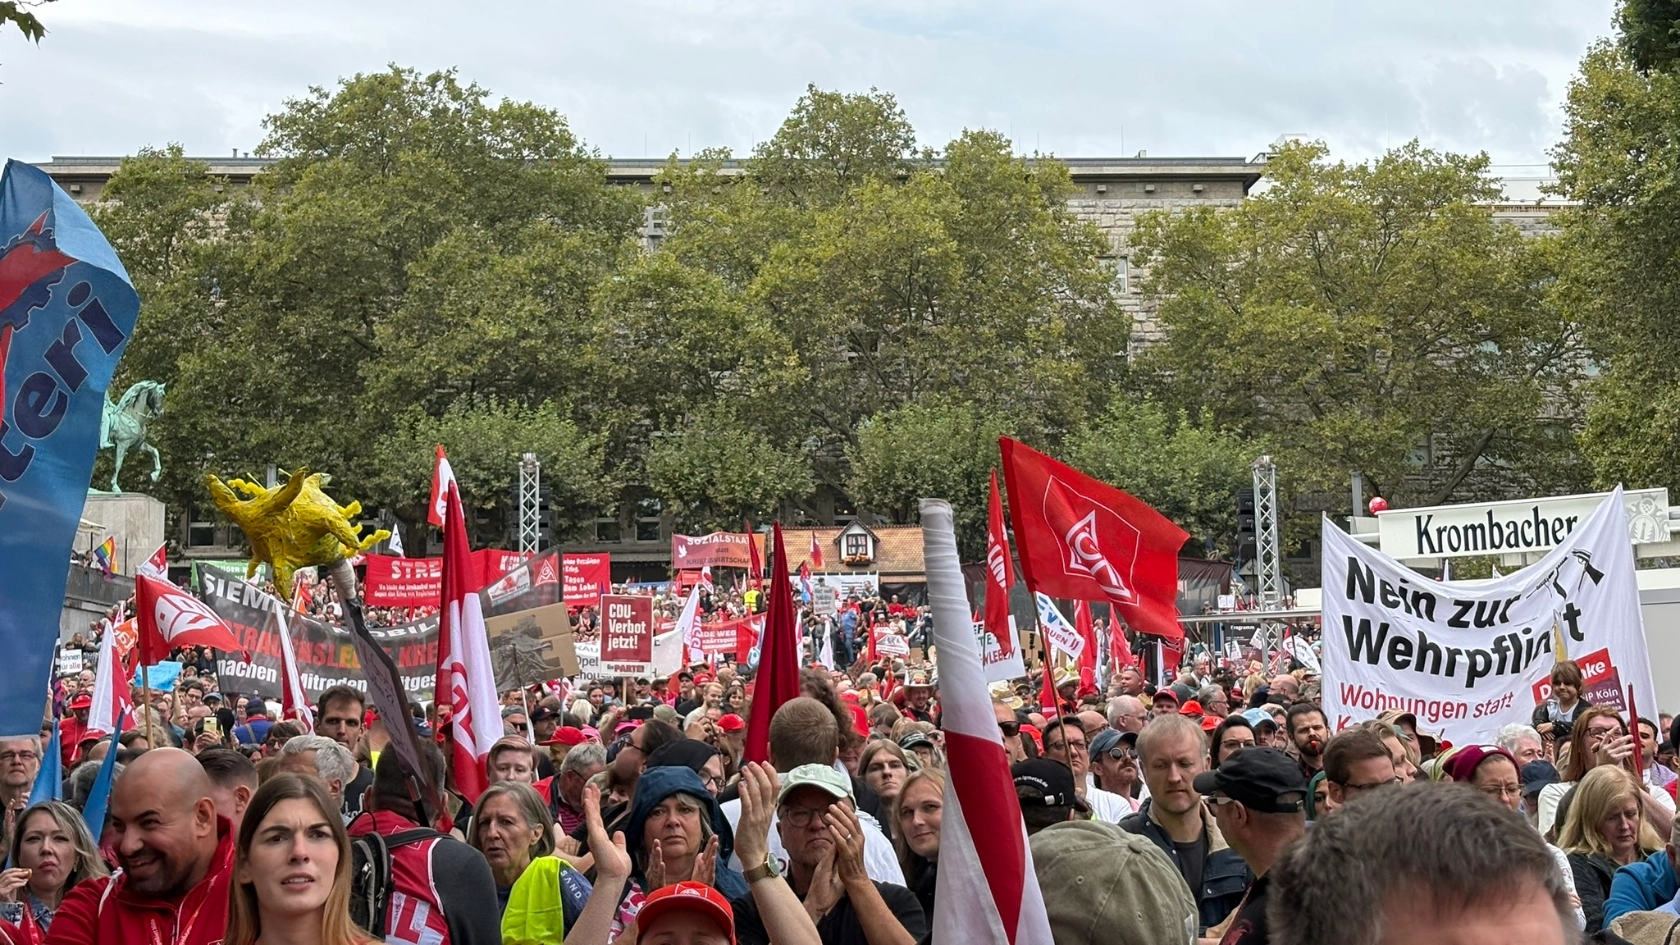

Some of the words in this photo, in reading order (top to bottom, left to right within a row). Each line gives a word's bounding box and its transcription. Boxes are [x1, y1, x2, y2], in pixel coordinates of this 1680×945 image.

[1415, 506, 1578, 555] Krombacher
[1345, 556, 1436, 623] Nein
[1446, 593, 1521, 629] zur
[609, 603, 636, 619] CDU-
[609, 619, 646, 634] Verbot
[607, 635, 638, 651] jetzt!
[614, 664, 645, 673] PARTEI
[1595, 688, 1619, 700] Köln
[1339, 682, 1468, 723] Wohnungen
[1473, 691, 1514, 719] statt
